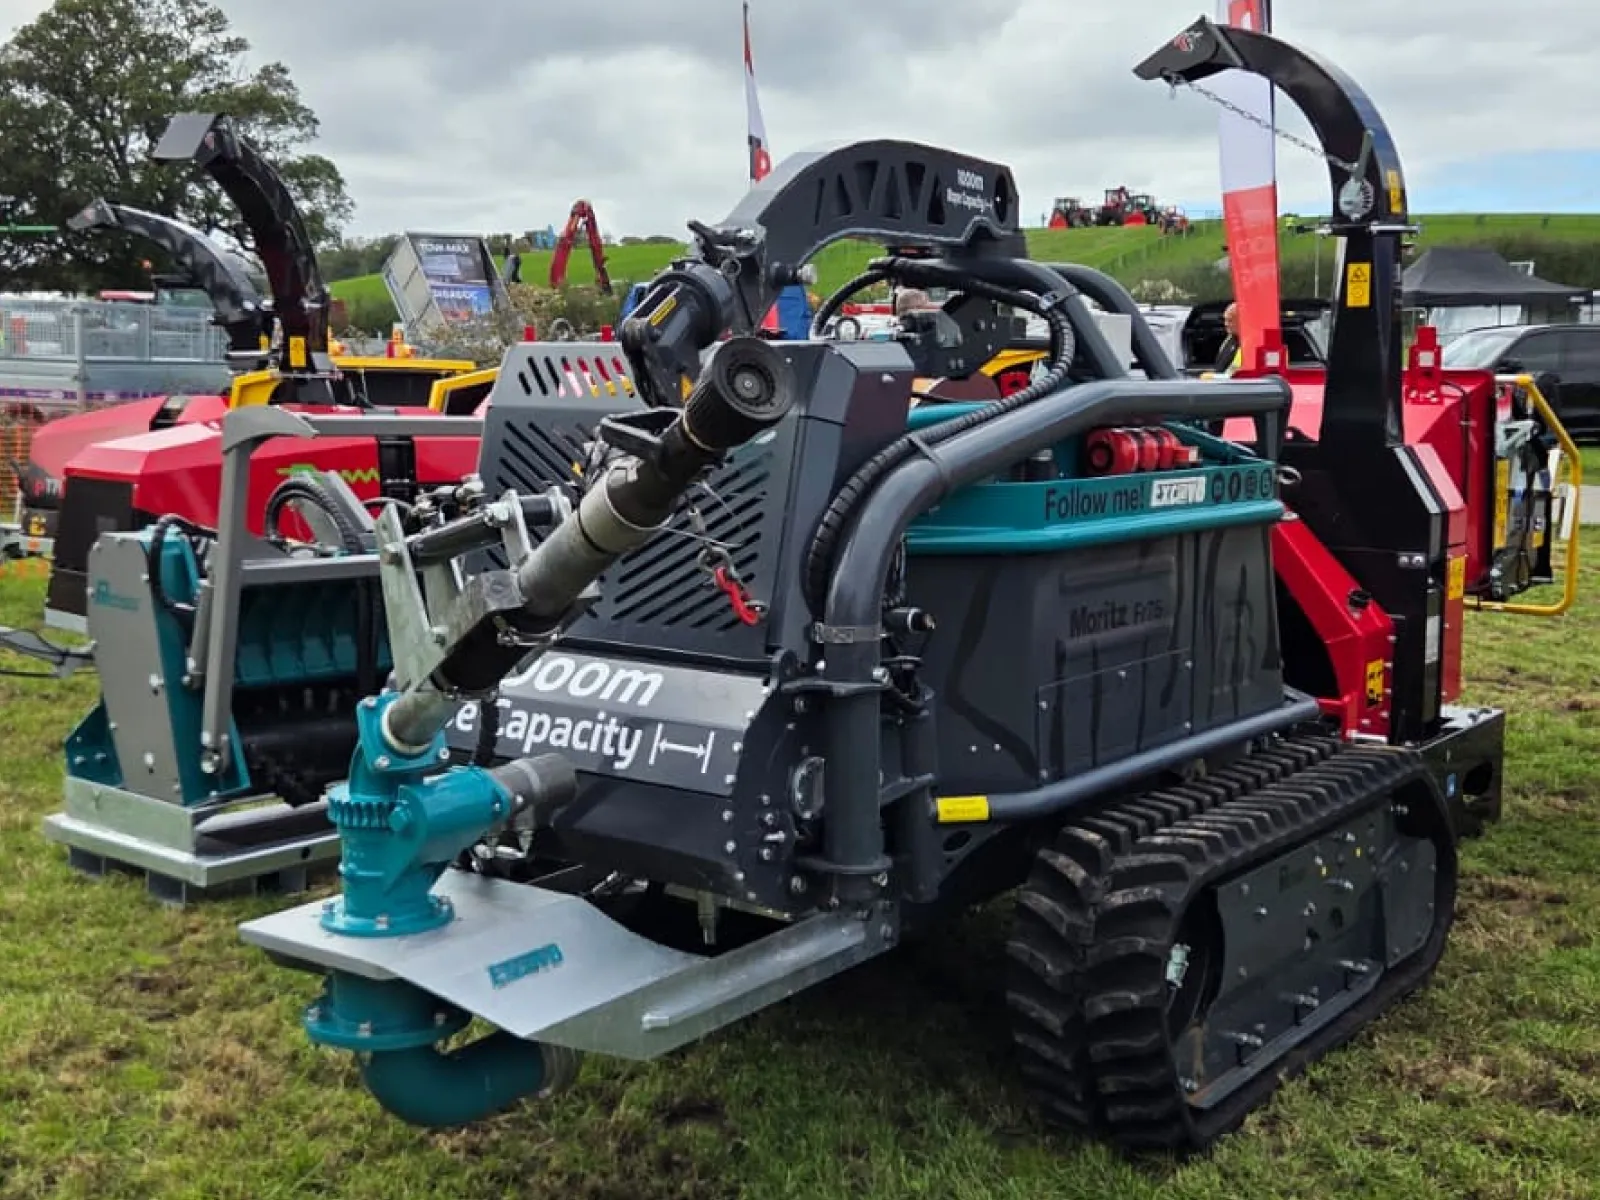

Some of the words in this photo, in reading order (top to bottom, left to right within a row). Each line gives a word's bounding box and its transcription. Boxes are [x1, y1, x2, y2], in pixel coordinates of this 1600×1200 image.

[1045, 484, 1107, 521] Follow
[1112, 483, 1145, 514] me!
[1070, 601, 1130, 637] Moritz
